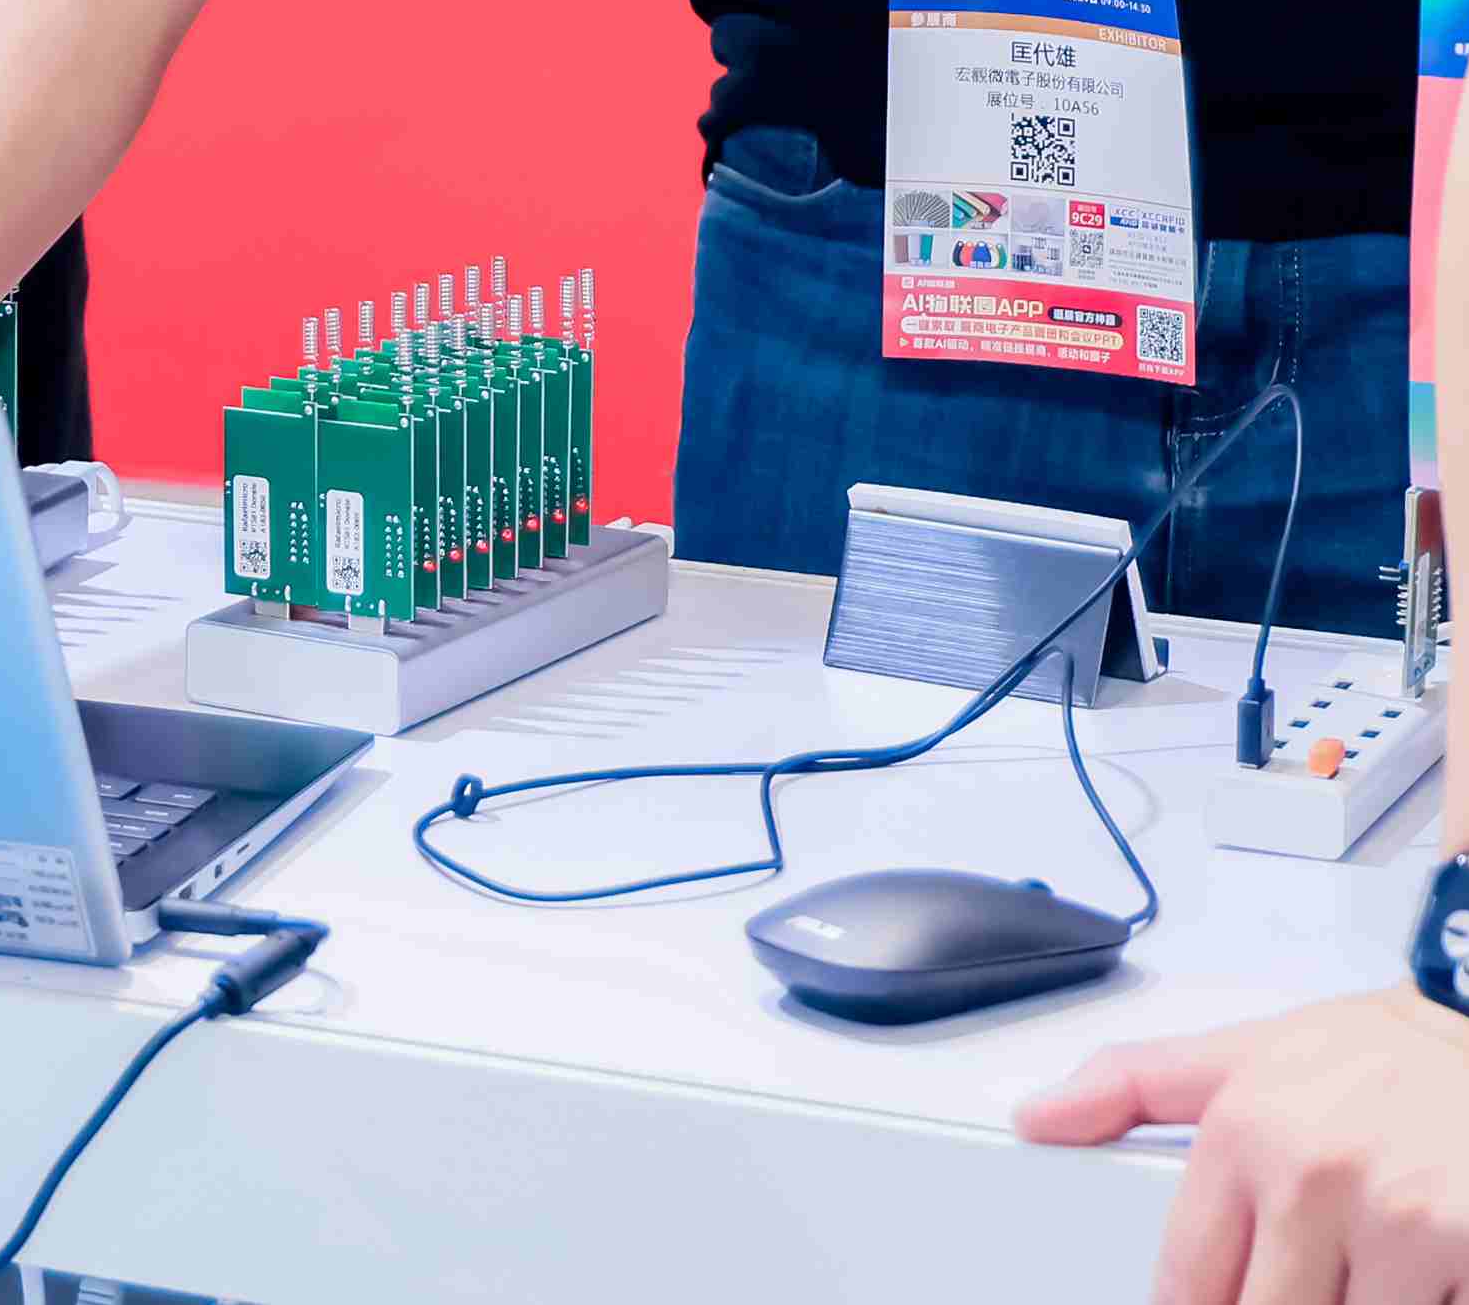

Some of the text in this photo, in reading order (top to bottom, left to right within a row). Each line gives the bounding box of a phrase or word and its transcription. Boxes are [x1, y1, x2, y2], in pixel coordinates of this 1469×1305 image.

[1098, 28, 1167, 52] EXHIBITOR
[1011, 41, 1076, 68] 匡代雄
[1071, 212, 1103, 226] 9C29
